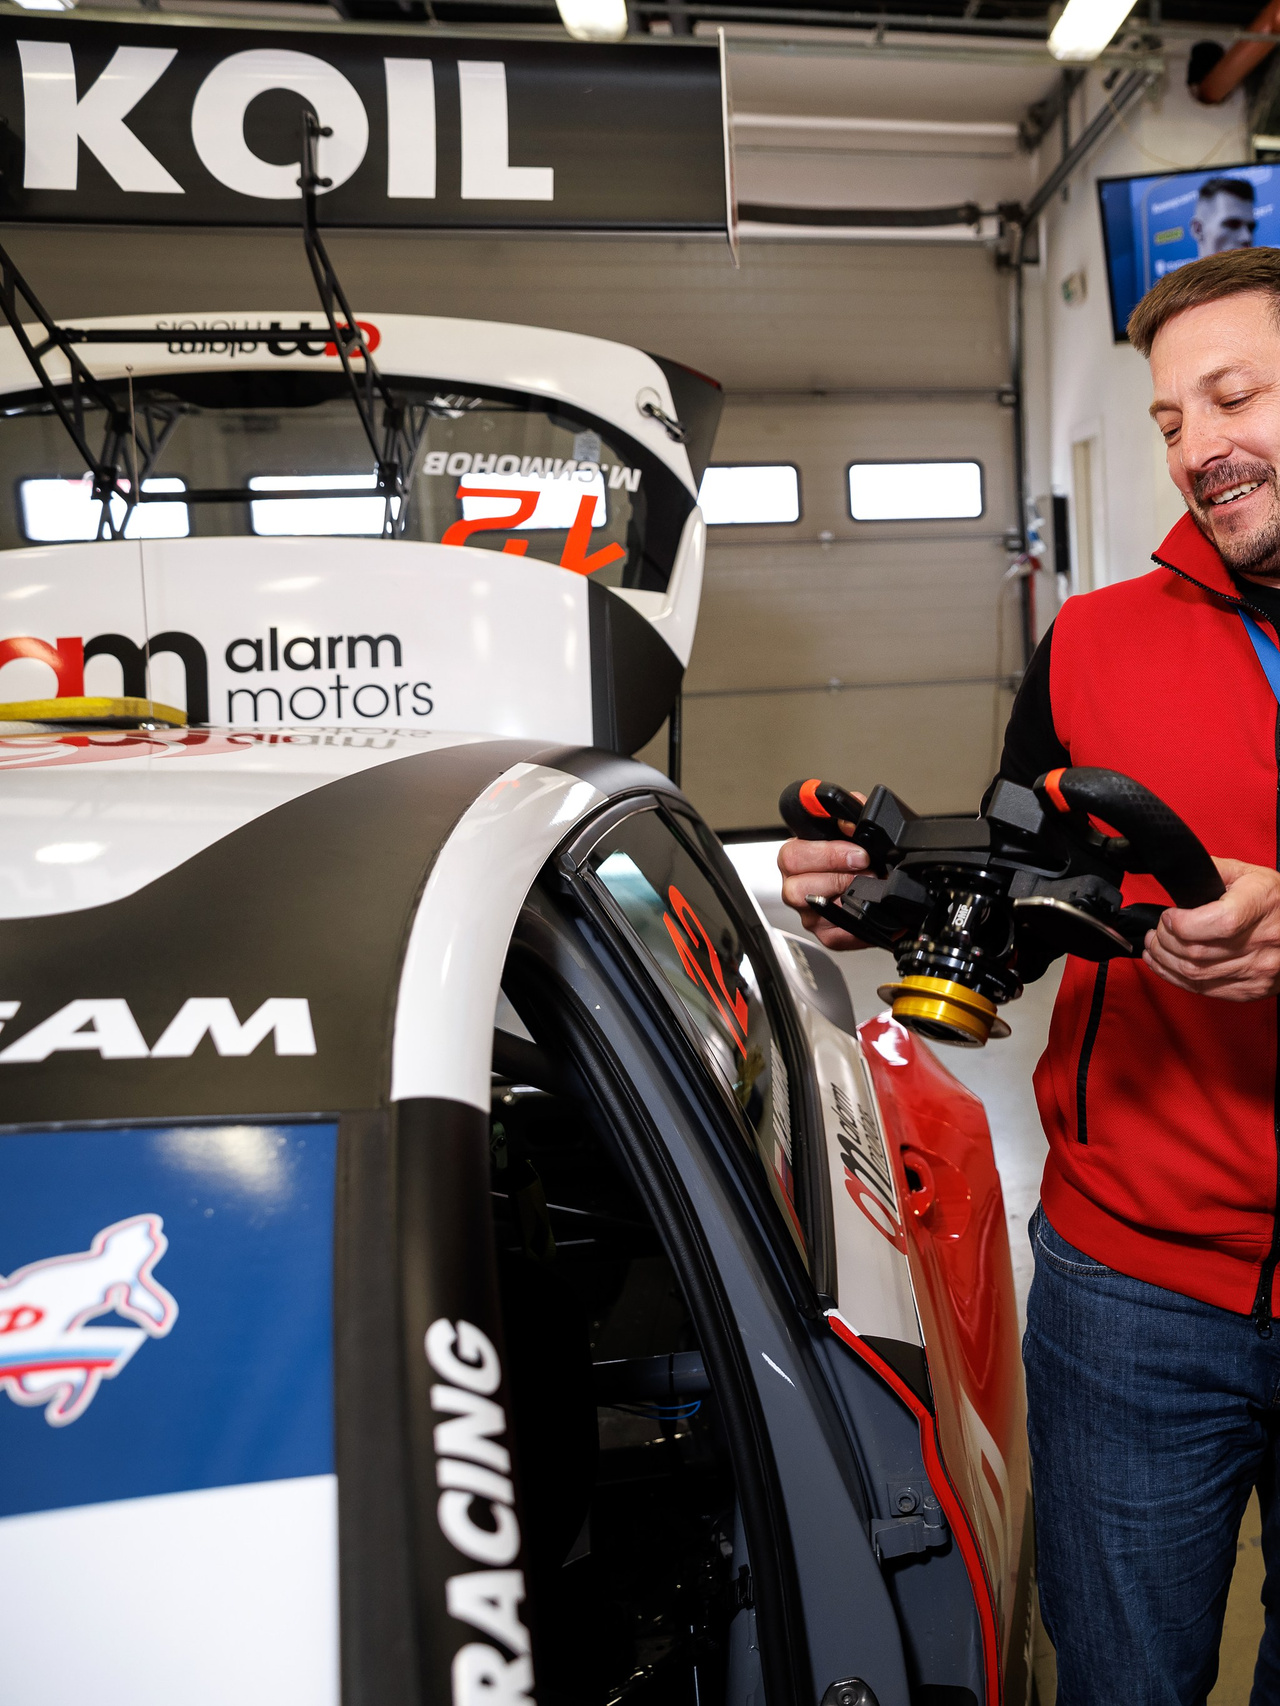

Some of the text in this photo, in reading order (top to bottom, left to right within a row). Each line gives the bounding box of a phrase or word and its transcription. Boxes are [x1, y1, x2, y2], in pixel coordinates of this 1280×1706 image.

[17, 40, 554, 199] KOIL
[225, 627, 402, 673] alarm
[227, 675, 433, 723] motors
[662, 885, 749, 1060] 12
[953, 904, 970, 927] OMP
[844, 1133, 907, 1255] am
[424, 1318, 534, 1706] RACING
